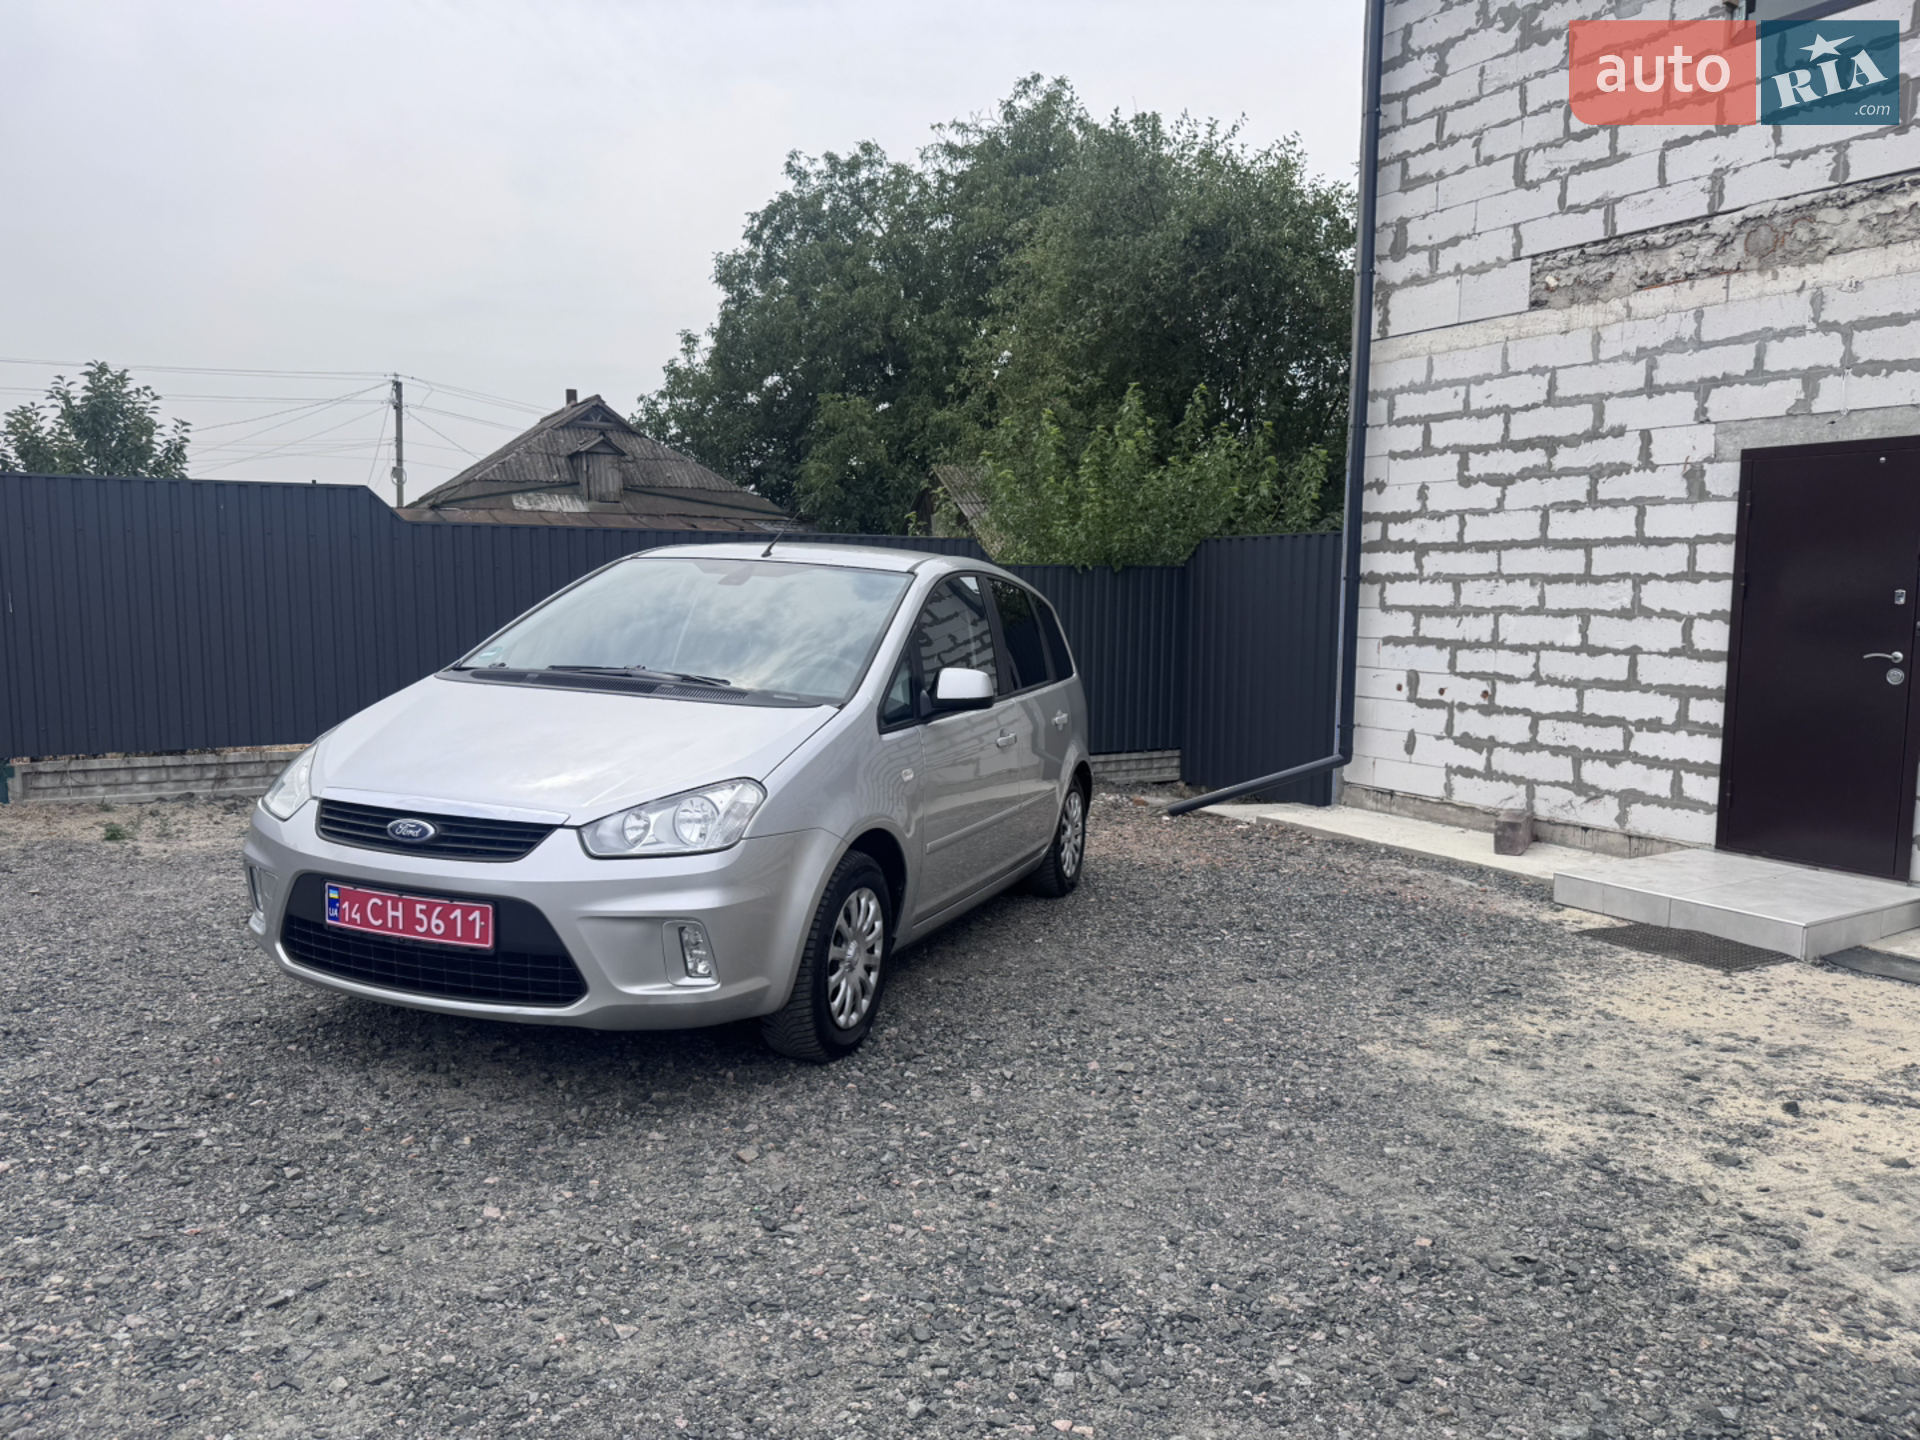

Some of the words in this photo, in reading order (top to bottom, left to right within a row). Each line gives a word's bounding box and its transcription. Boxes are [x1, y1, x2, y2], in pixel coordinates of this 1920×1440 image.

[395, 823, 422, 837] Ford
[328, 907, 339, 918] UA
[342, 901, 361, 924] 14
[366, 897, 403, 930] CH
[415, 904, 481, 940] 5611
